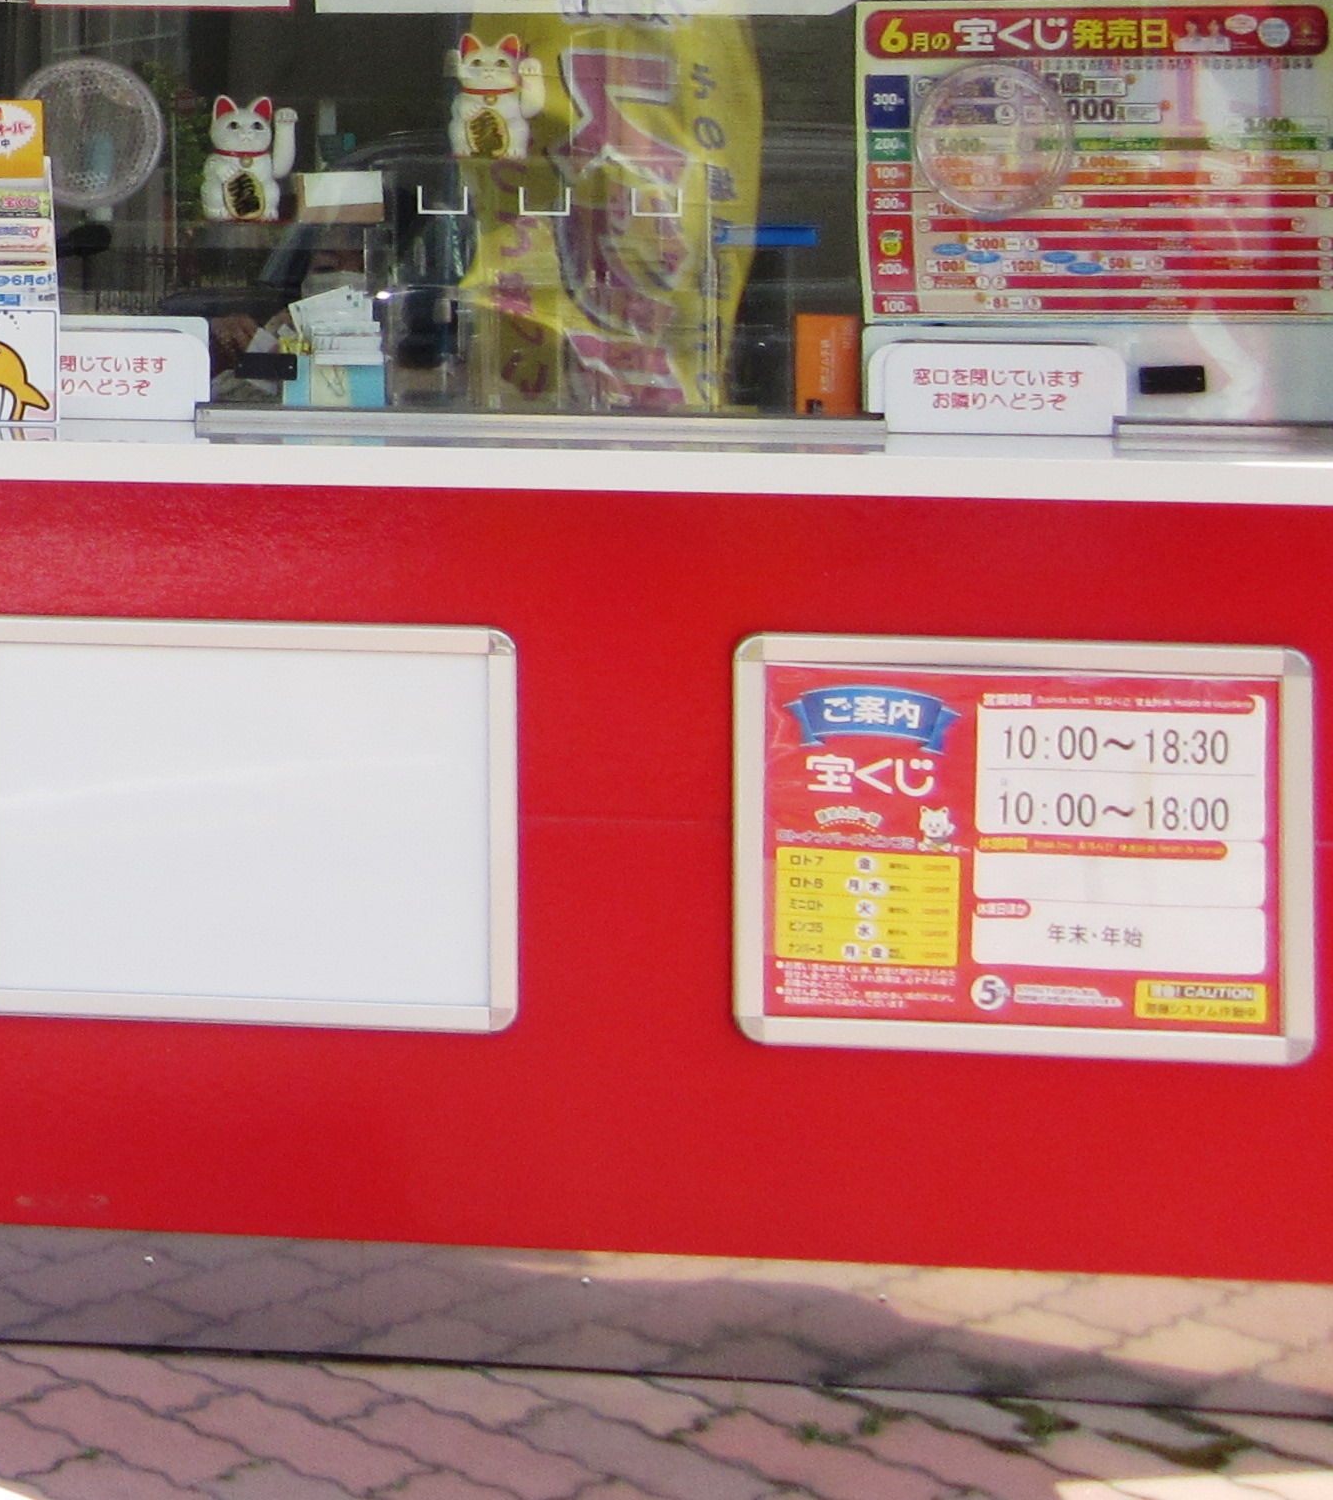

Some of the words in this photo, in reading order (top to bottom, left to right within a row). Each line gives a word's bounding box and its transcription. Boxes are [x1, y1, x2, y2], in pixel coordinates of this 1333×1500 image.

[60, 355, 167, 374] 閉じています
[60, 379, 153, 397] りへどうぞ
[913, 369, 1083, 388] 窓口を閉じています
[932, 392, 1068, 412] お隣りへどうぞ
[823, 695, 921, 730] ご案内
[805, 753, 935, 798] 宝くじ
[789, 854, 824, 866] ロト7
[858, 857, 871, 870] 金
[789, 876, 824, 889] ロト6
[848, 879, 861, 891] 月
[868, 880, 881, 892] 木
[789, 898, 825, 910] ミニロト
[857, 902, 871, 914] 火
[789, 921, 824, 933] ビンゴ5
[1047, 923, 1144, 948] 年末・年始
